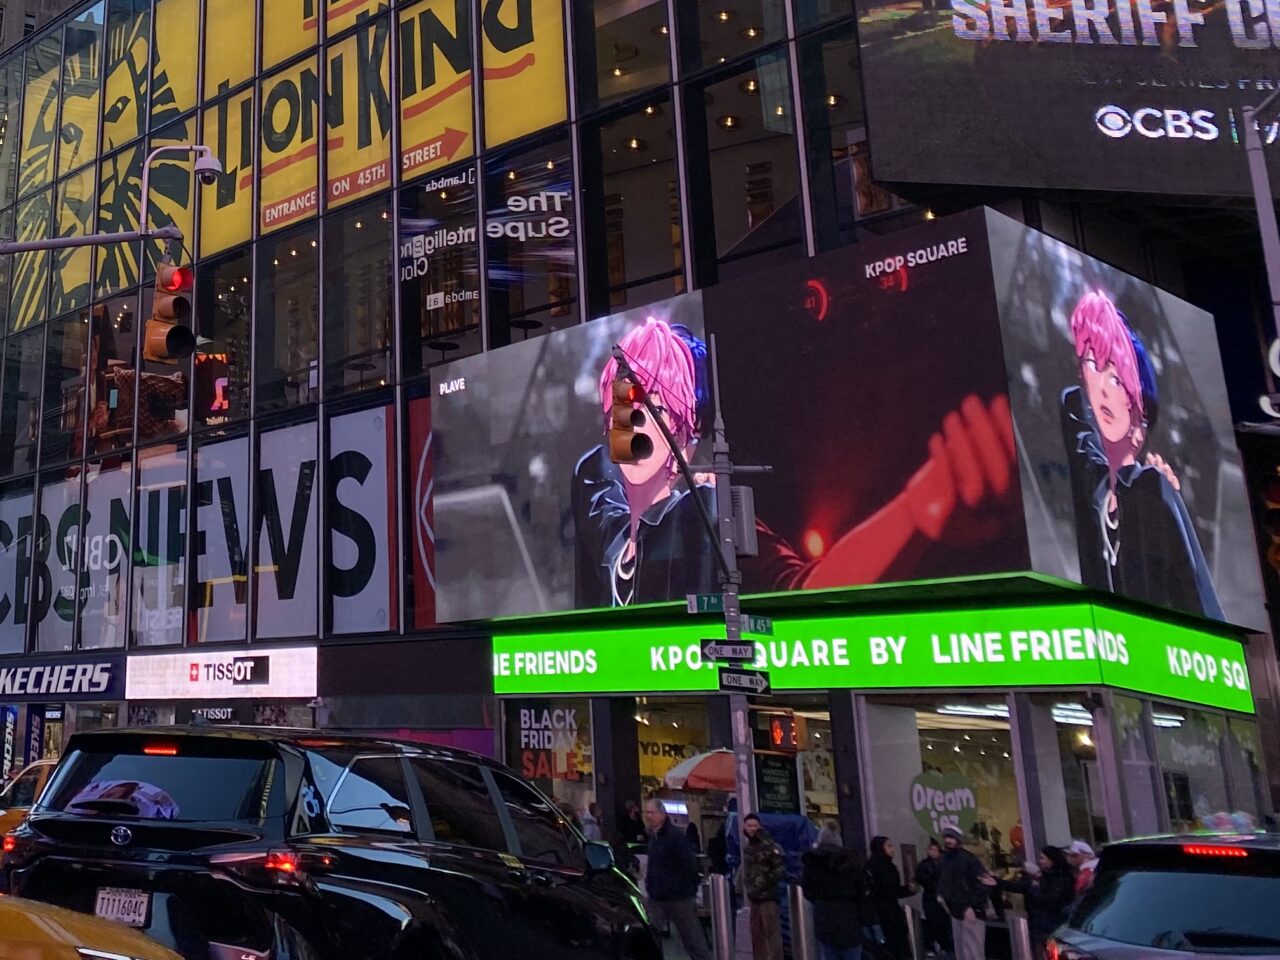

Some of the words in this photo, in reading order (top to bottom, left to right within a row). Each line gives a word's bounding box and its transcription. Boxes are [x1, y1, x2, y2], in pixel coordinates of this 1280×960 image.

[217, 53, 344, 210] LION
[1133, 108, 1218, 140] CBS
[265, 193, 317, 222] ENTRANCE
[333, 179, 350, 197] ON
[358, 165, 386, 186] 45TH
[403, 141, 442, 169] STREET
[865, 256, 904, 278] KPOP
[907, 238, 968, 267] SQUARE
[440, 378, 465, 395] PLAVE
[109, 449, 376, 617] NEWS
[703, 597, 708, 610] 7
[756, 619, 766, 632] 45
[709, 647, 725, 656] ONE
[732, 648, 748, 656] WAY
[870, 636, 907, 665] BY
[931, 631, 1005, 665] LINE
[1012, 628, 1130, 666] FRIENDS
[204, 661, 254, 681] TISSOT
[514, 650, 597, 676] FRIENDS
[1166, 645, 1217, 683] KPOP
[727, 675, 742, 685] ONE
[750, 678, 764, 687] WAY
[203, 708, 232, 720] TISSOT
[520, 709, 578, 729] BLACK
[521, 730, 578, 749] FRIDAY
[522, 751, 579, 779] SALE
[912, 783, 976, 811] Dream
